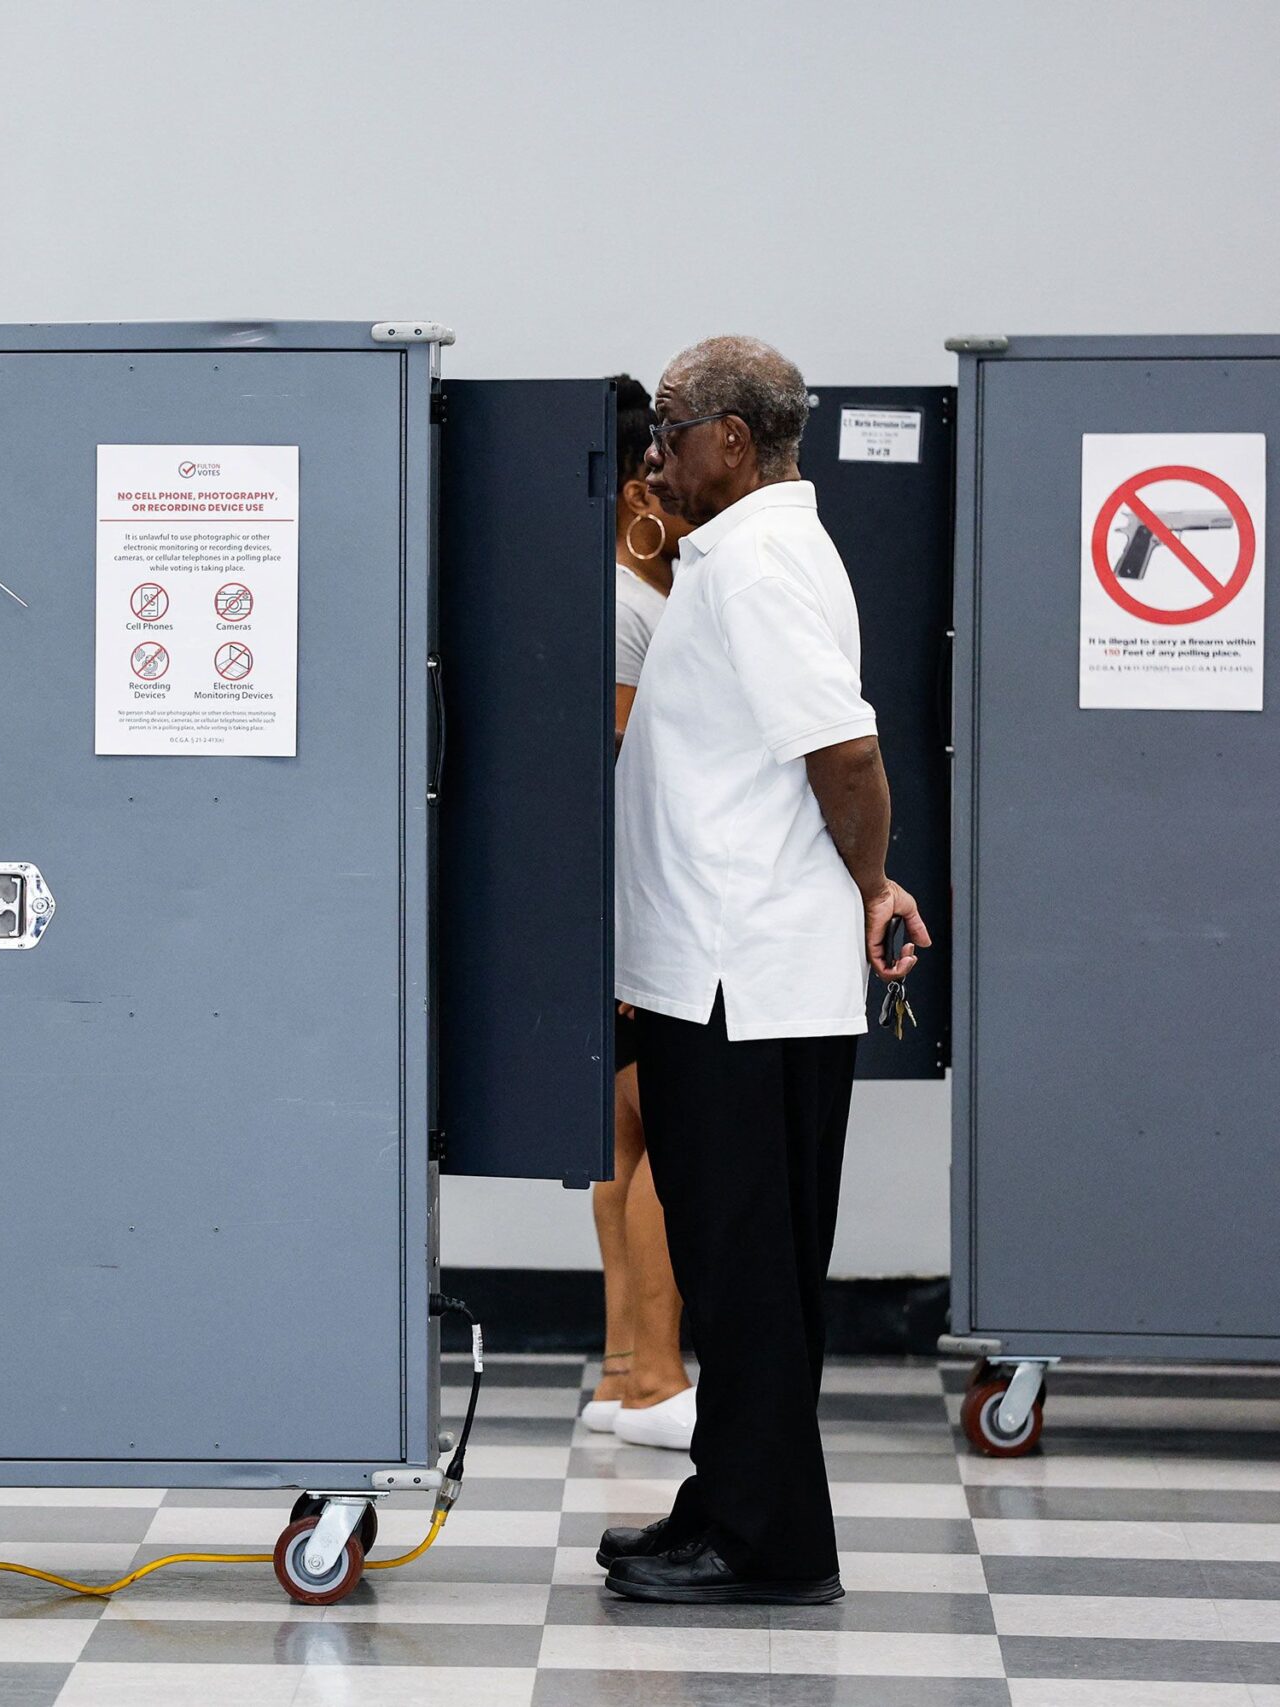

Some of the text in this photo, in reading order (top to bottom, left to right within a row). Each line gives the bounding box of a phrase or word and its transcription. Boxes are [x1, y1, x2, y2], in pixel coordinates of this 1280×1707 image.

[118, 492, 277, 500] NO CELL PHONE, PHOTOGRAPHY,
[193, 534, 240, 542] photographic
[209, 544, 243, 552] recording
[182, 554, 221, 562] telephones
[236, 554, 261, 562] polling
[262, 554, 281, 562] place
[170, 565, 192, 573] voting
[201, 565, 223, 573] taking
[1109, 638, 1137, 646] illegal
[1178, 650, 1210, 658] polling
[1212, 650, 1240, 658] place.
[129, 682, 171, 690] Recording
[213, 682, 253, 690] Electronic
[194, 692, 240, 700] Monitoring
